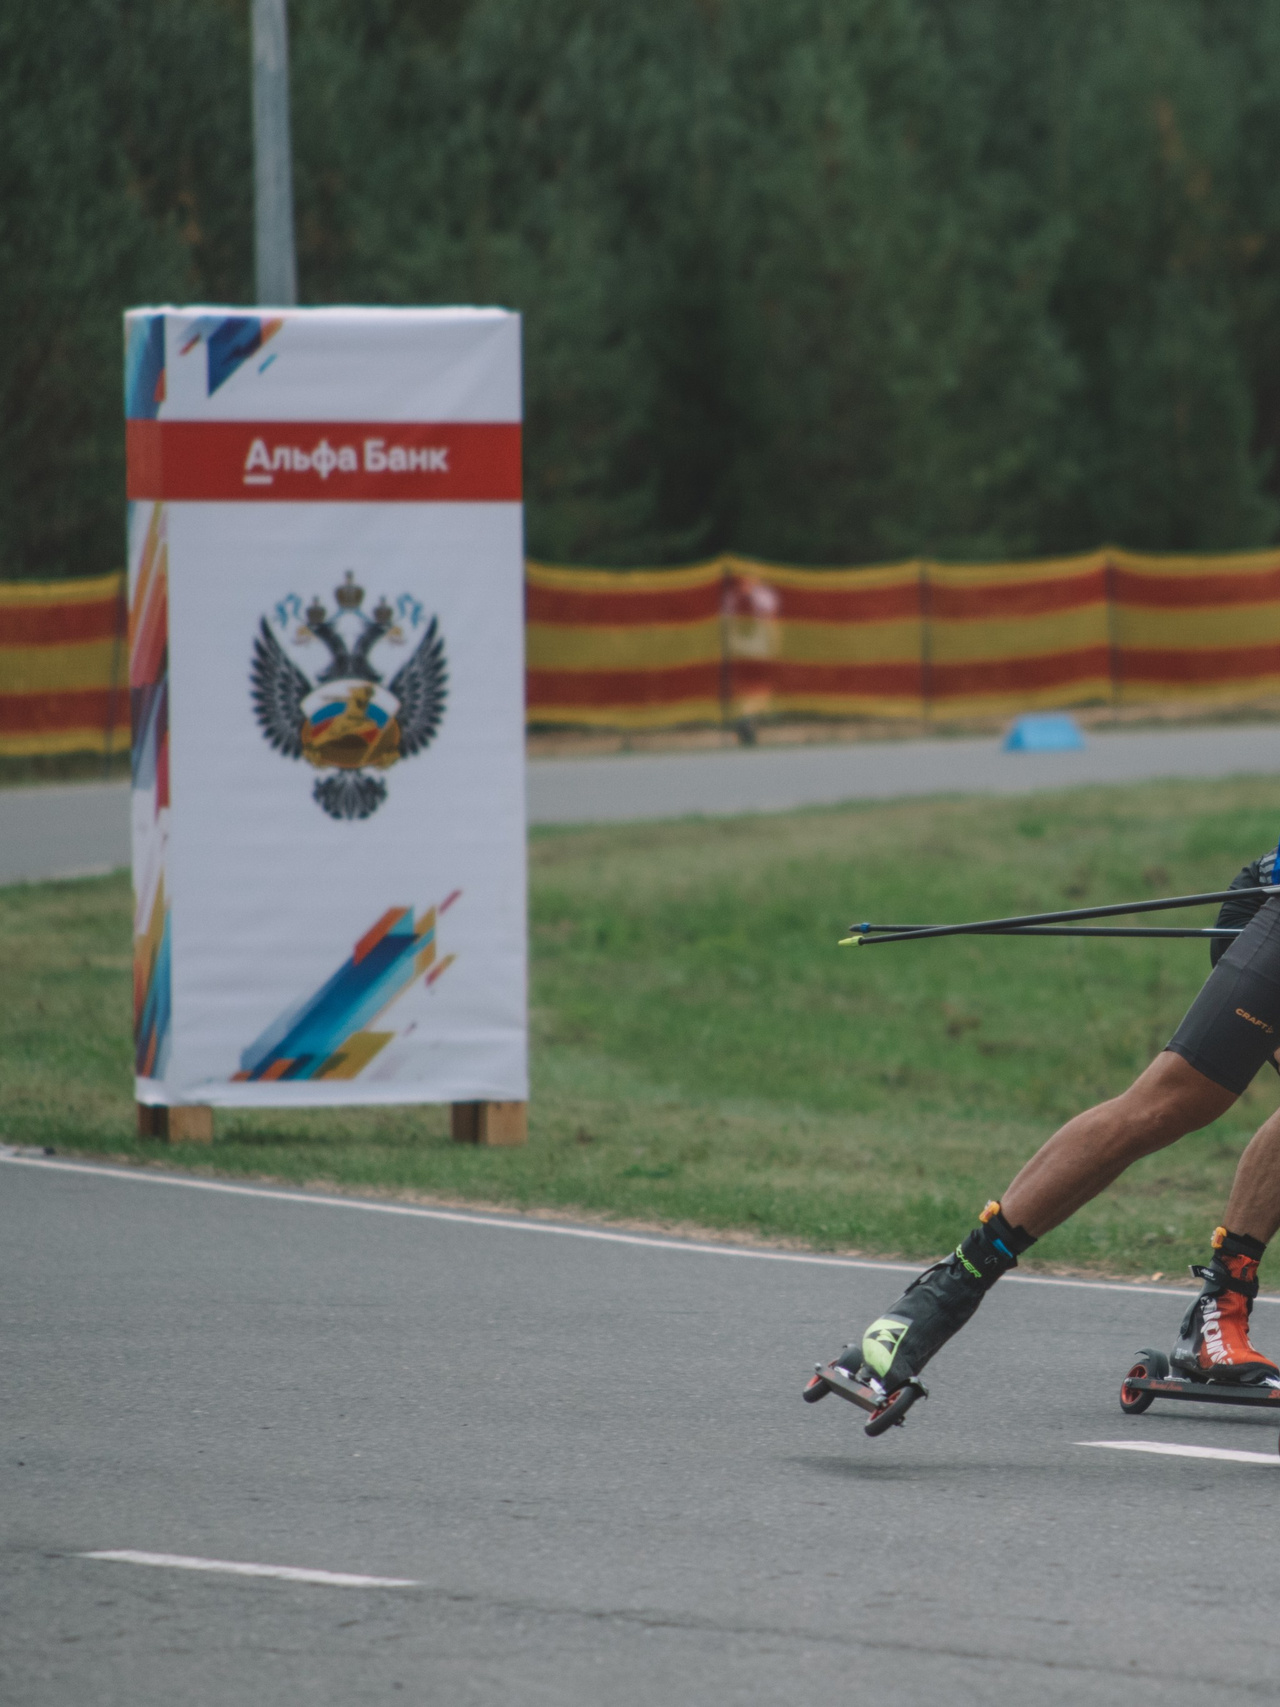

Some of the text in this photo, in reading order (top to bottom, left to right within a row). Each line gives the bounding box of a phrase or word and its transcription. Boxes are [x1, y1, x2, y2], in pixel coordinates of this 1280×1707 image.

[244, 437, 448, 482] Альфа Банк
[1235, 1008, 1267, 1029] CRAFT
